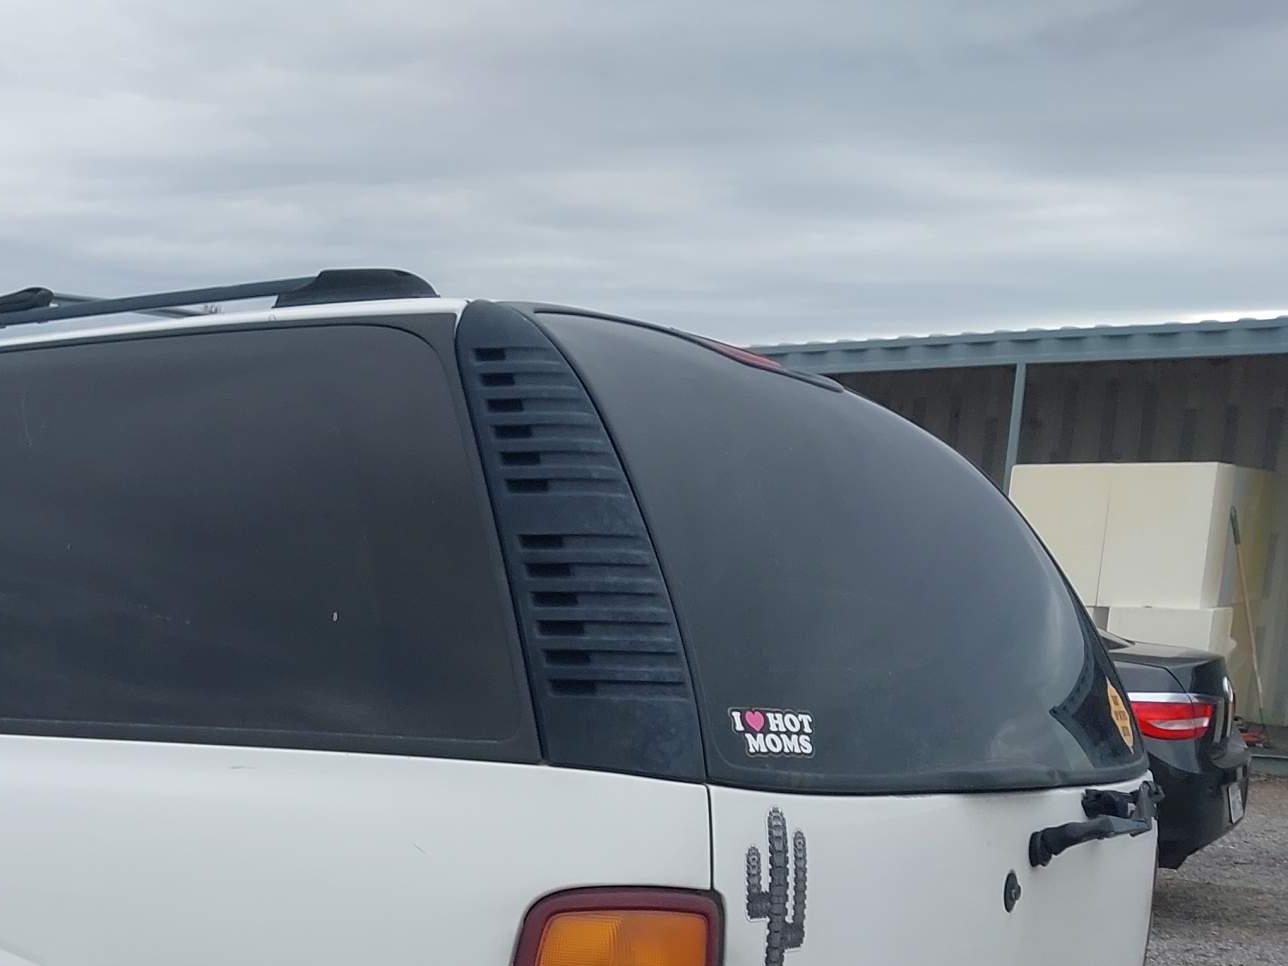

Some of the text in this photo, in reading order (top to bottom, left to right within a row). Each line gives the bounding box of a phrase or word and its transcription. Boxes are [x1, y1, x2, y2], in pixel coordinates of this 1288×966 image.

[731, 711, 813, 733] I HOT
[744, 733, 813, 754] MOMS
